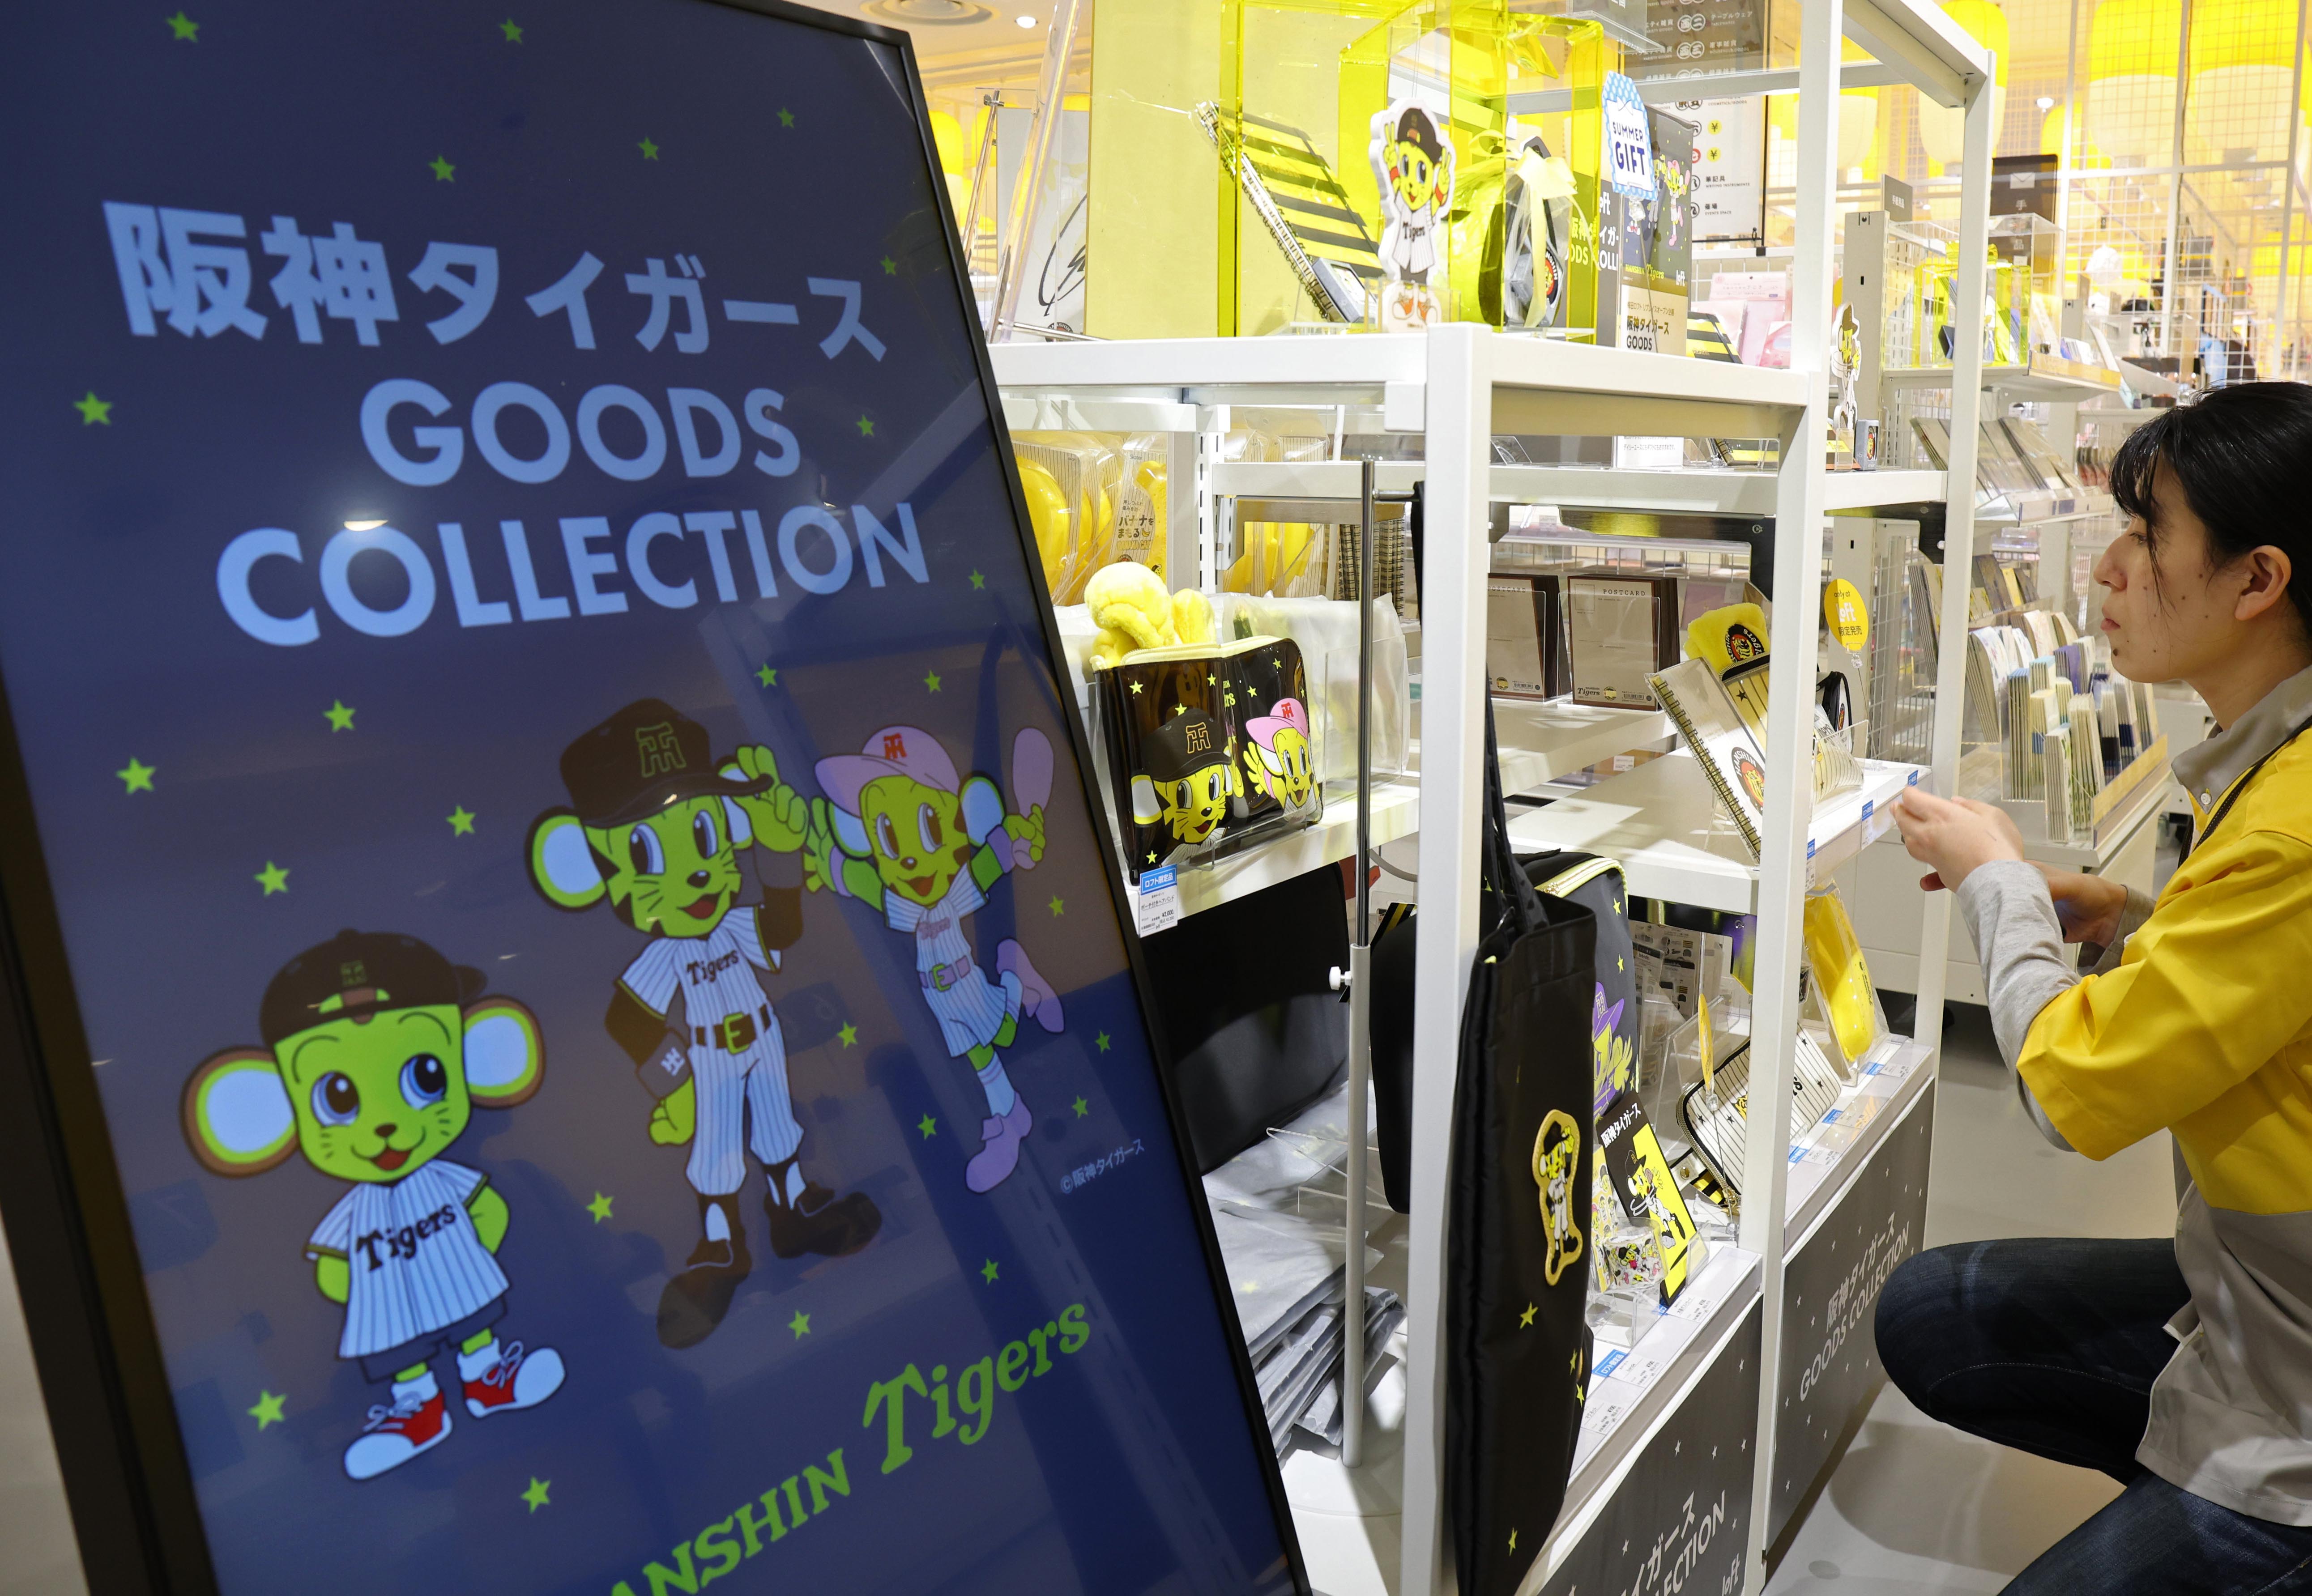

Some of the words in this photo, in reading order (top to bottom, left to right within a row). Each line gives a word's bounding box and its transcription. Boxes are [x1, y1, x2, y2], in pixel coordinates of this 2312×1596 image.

[1613, 121, 1644, 143] SUMMER
[1615, 141, 1645, 175] GIFT
[1402, 221, 1426, 243] Tigers
[102, 200, 887, 362] 阪神タイガース
[1625, 264, 1645, 275] HANSHIN
[1646, 263, 1664, 281] Tigers
[1627, 315, 1669, 335] 阪神タイガース
[1627, 336, 1652, 351] GOODS
[360, 378, 801, 487] GOODS
[1119, 515, 1154, 527] バナナを
[1118, 528, 1140, 539] まもる
[216, 502, 931, 647] COLLECTION
[1834, 589, 1844, 600] only
[1838, 626, 1862, 637] 限定発売
[1577, 687, 1600, 696] Tigers
[1734, 750, 1757, 777] HANSHIN
[1145, 872, 1173, 888] ロフト限定品
[1141, 895, 1175, 909] ポーチ付きヘアバンド
[687, 949, 740, 986] Tigers
[1600, 1102, 1642, 1148] 阪神タイガース
[356, 1203, 457, 1272] Tigers
[1826, 1211, 1895, 1333] 阪神タイガース
[1800, 1315, 1847, 1402] GOODS
[1849, 1221, 1909, 1330] COLLECTION
[1601, 1353, 1625, 1374] ロフト限定品
[862, 1303, 1090, 1474] Tigers
[1621, 1490, 1695, 1596] イガース
[1655, 1489, 1725, 1596] ECTION
